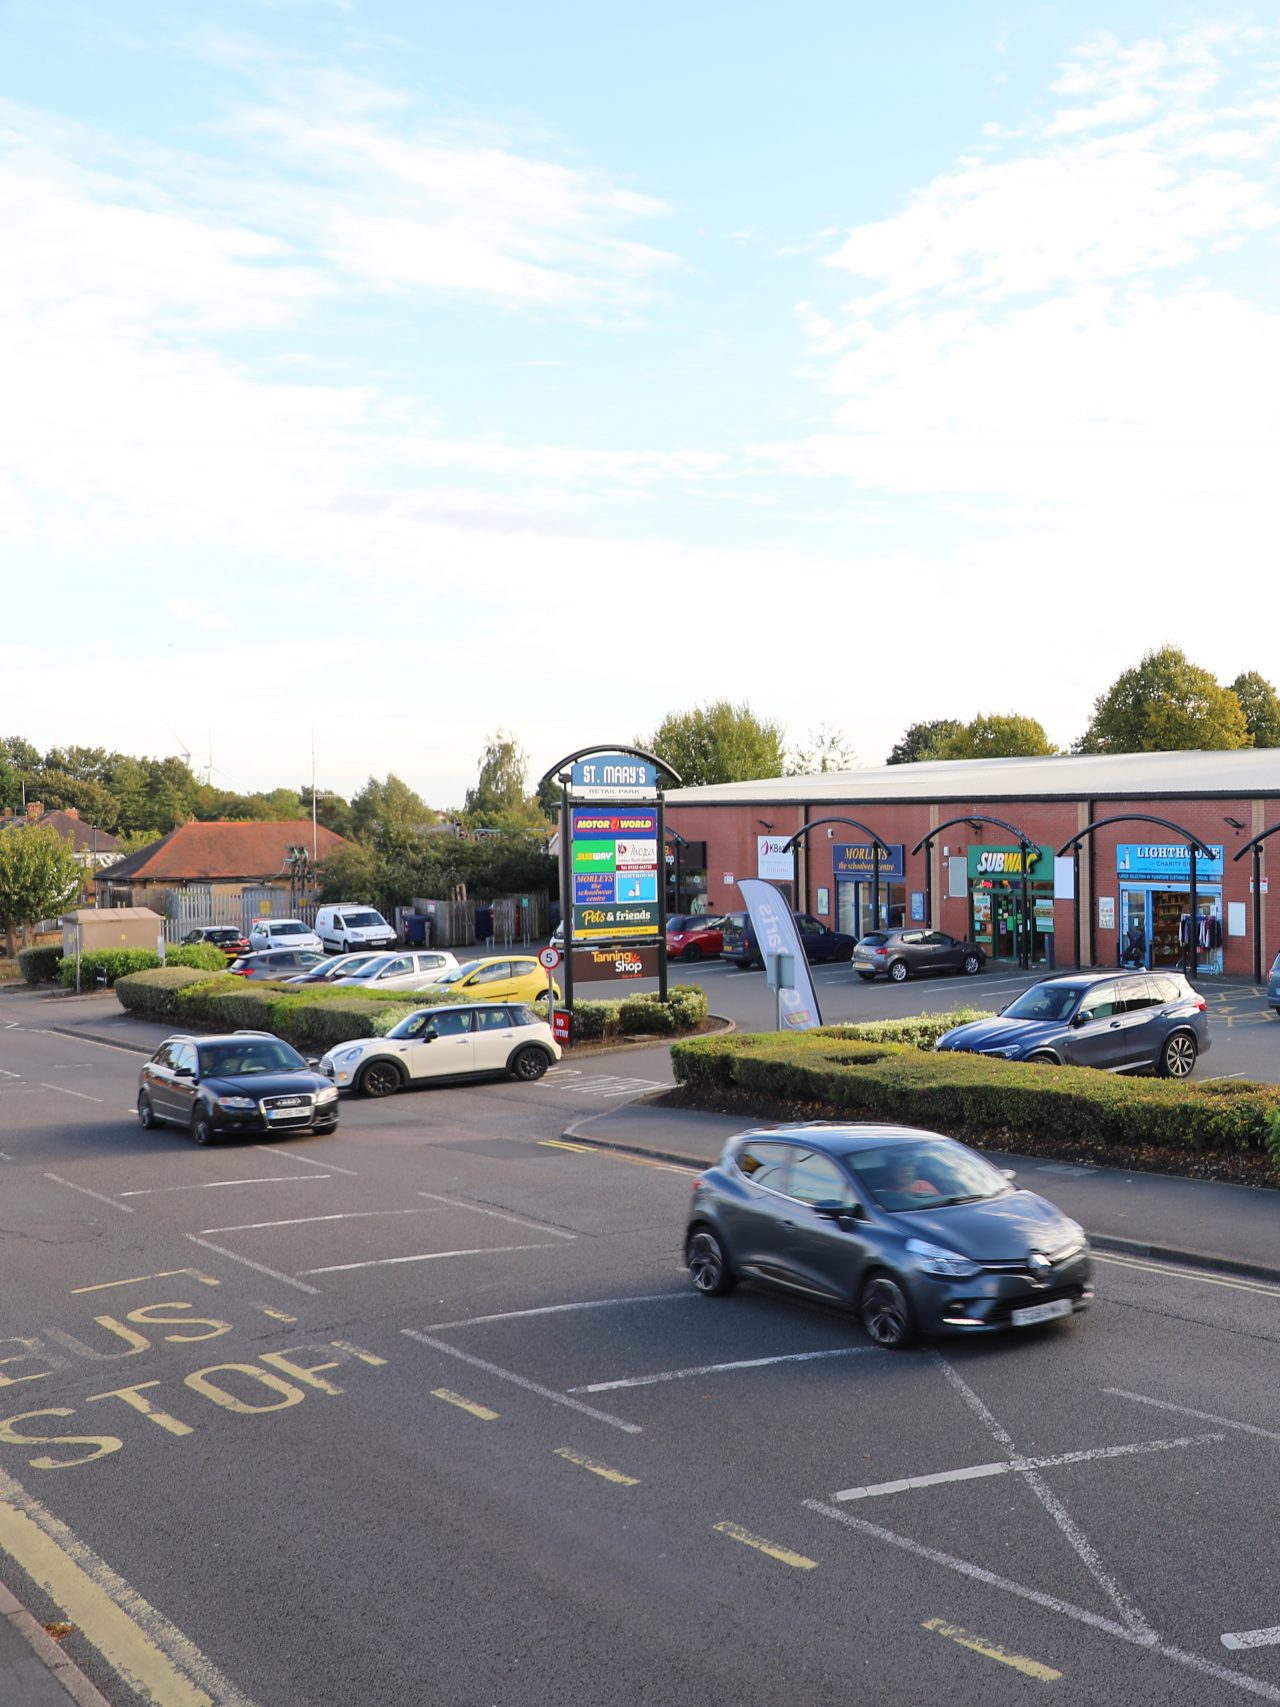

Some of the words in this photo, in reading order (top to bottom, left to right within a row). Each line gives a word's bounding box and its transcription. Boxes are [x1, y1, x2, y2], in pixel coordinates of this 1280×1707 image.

[583, 765, 600, 784] ST.
[603, 765, 646, 784] MARY'S
[577, 820, 610, 829] MOTOR
[620, 820, 652, 829] WORLD
[576, 852, 613, 860] SUBWAY
[838, 861, 846, 869] the
[576, 875, 613, 883] MORLEYS
[582, 909, 605, 926] Pets
[606, 911, 614, 921] &
[616, 910, 651, 920] friends
[546, 953, 553, 963] 5
[591, 950, 632, 964] Tanning
[615, 960, 642, 974] Shop
[556, 1018, 564, 1027] NO
[555, 1028, 569, 1038] NTRY
[0, 1302, 234, 1388] BUS
